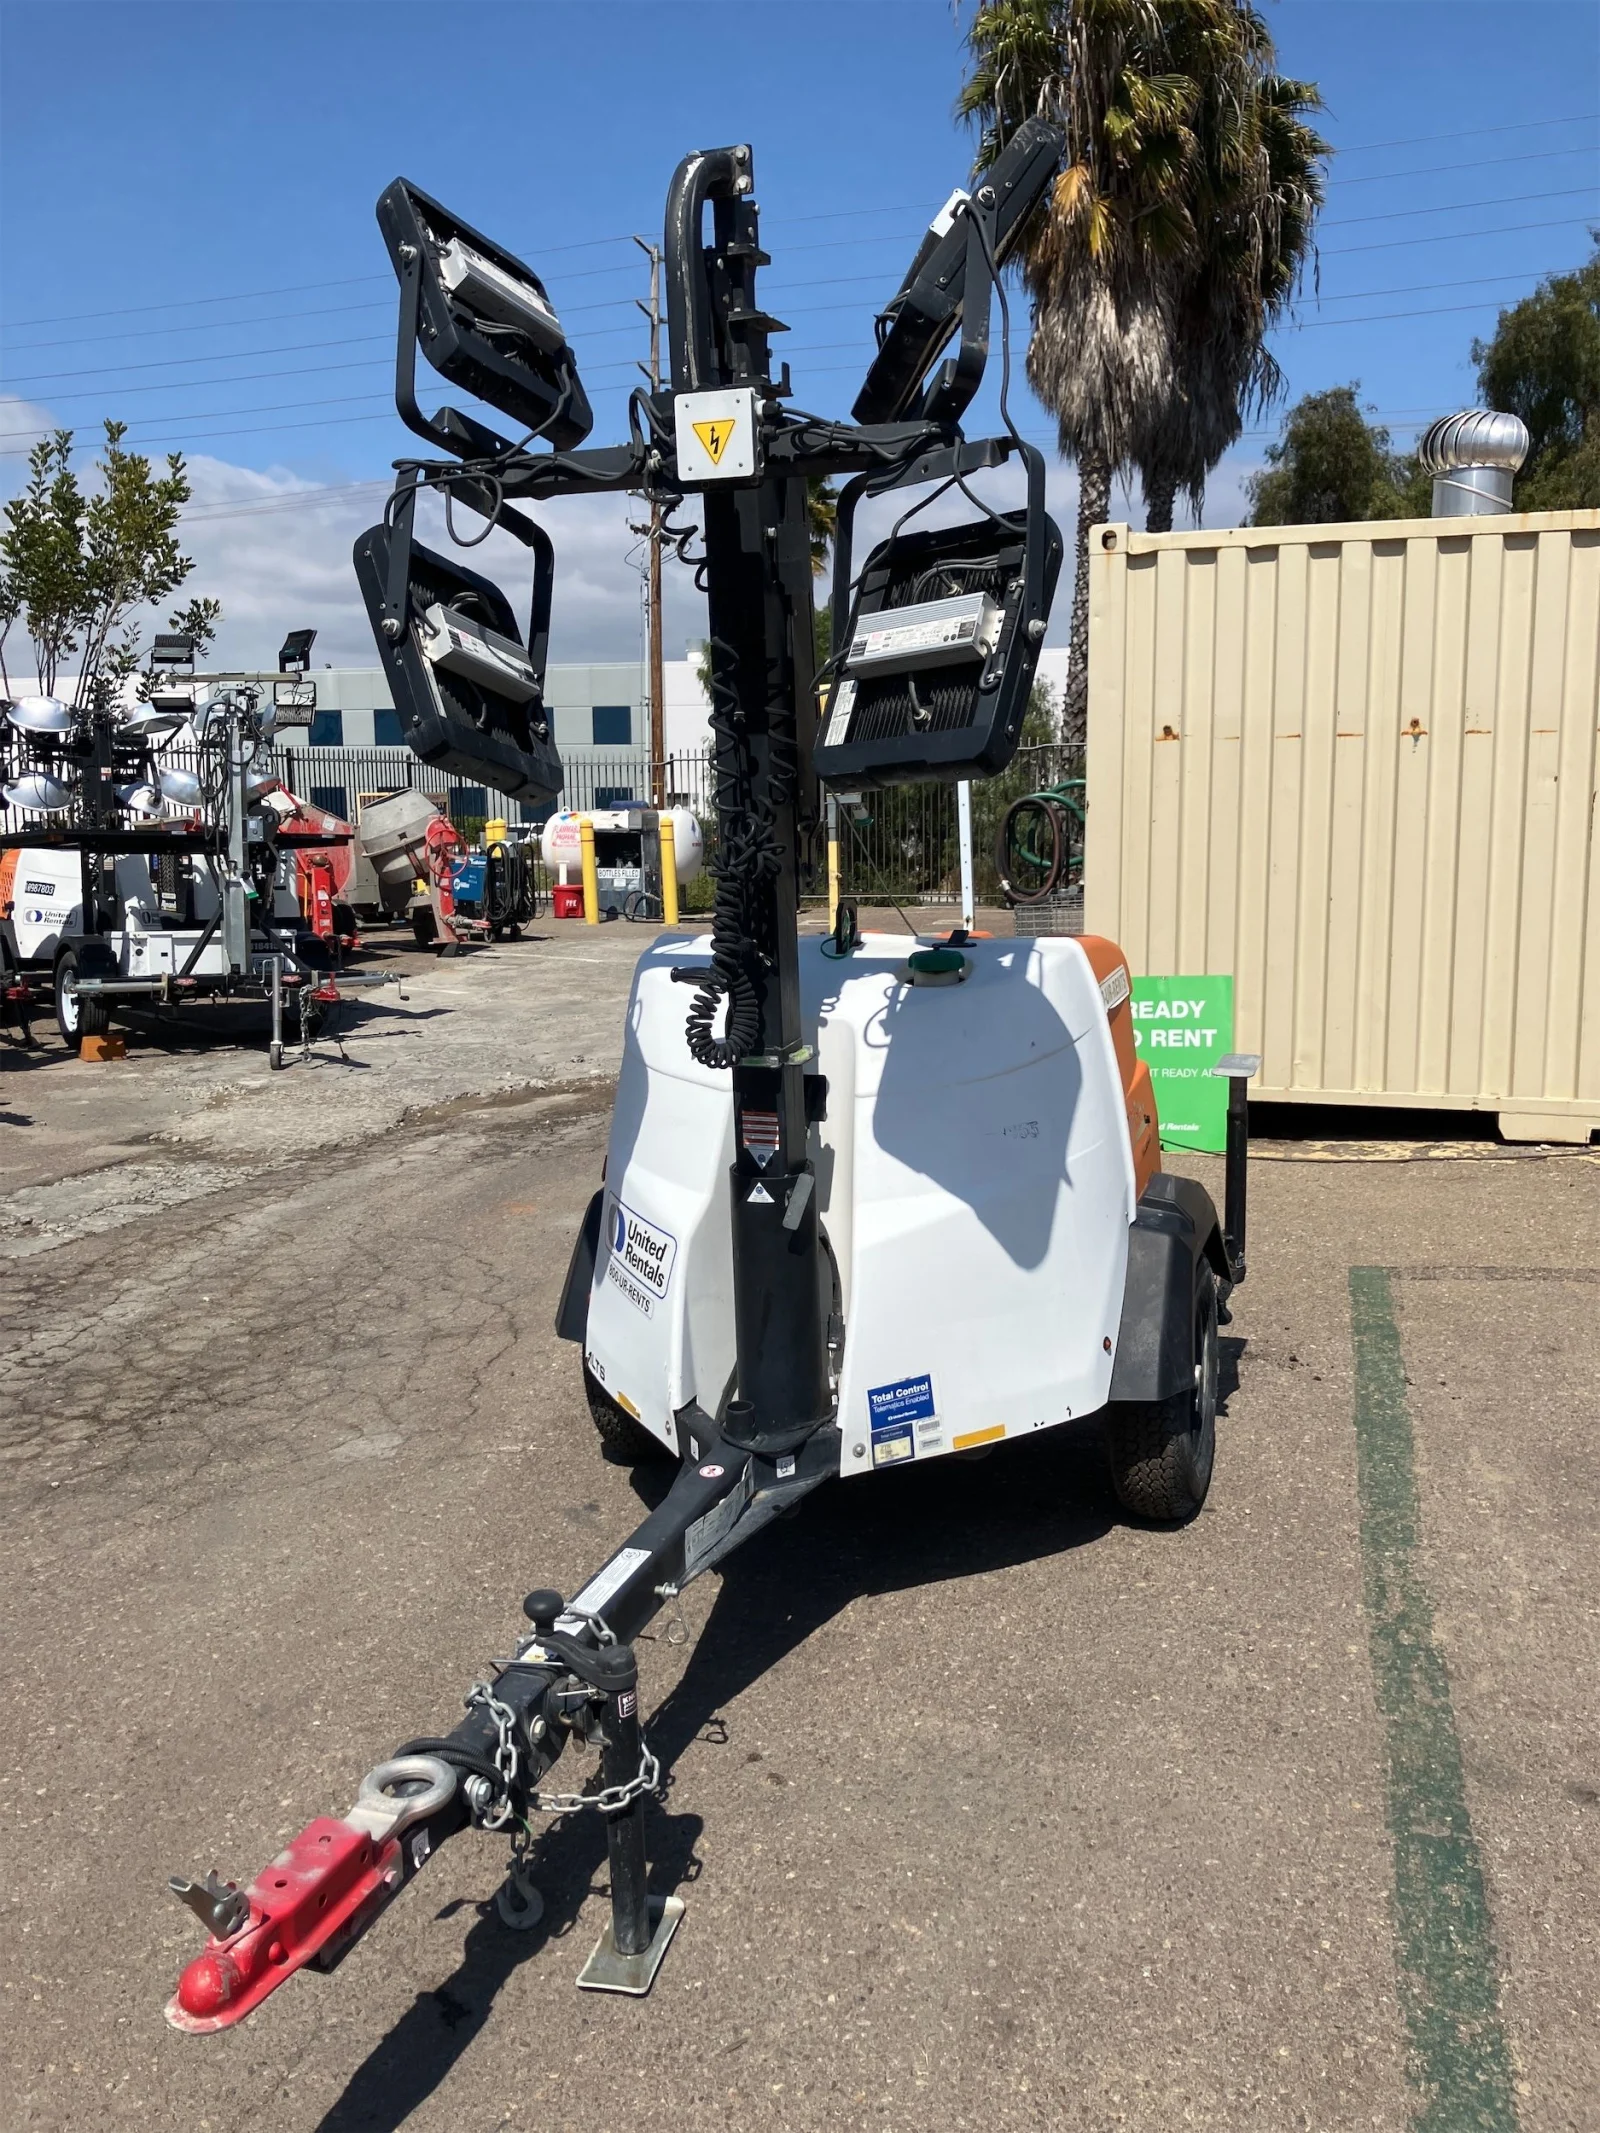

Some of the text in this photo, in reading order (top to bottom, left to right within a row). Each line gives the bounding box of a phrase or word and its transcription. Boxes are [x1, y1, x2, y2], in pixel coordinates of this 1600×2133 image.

[599, 870, 639, 878] BOTTLES FILLED
[1150, 1029, 1217, 1047] RENT
[1161, 1068, 1199, 1078] READY
[1166, 1122, 1200, 1131] Rentals
[627, 1219, 668, 1262] United
[624, 1242, 665, 1288] Rentals
[608, 1263, 651, 1313] 800-UR-RENTS
[872, 1382, 929, 1403] Total Control
[873, 1392, 930, 1413] Telematics Enabled
